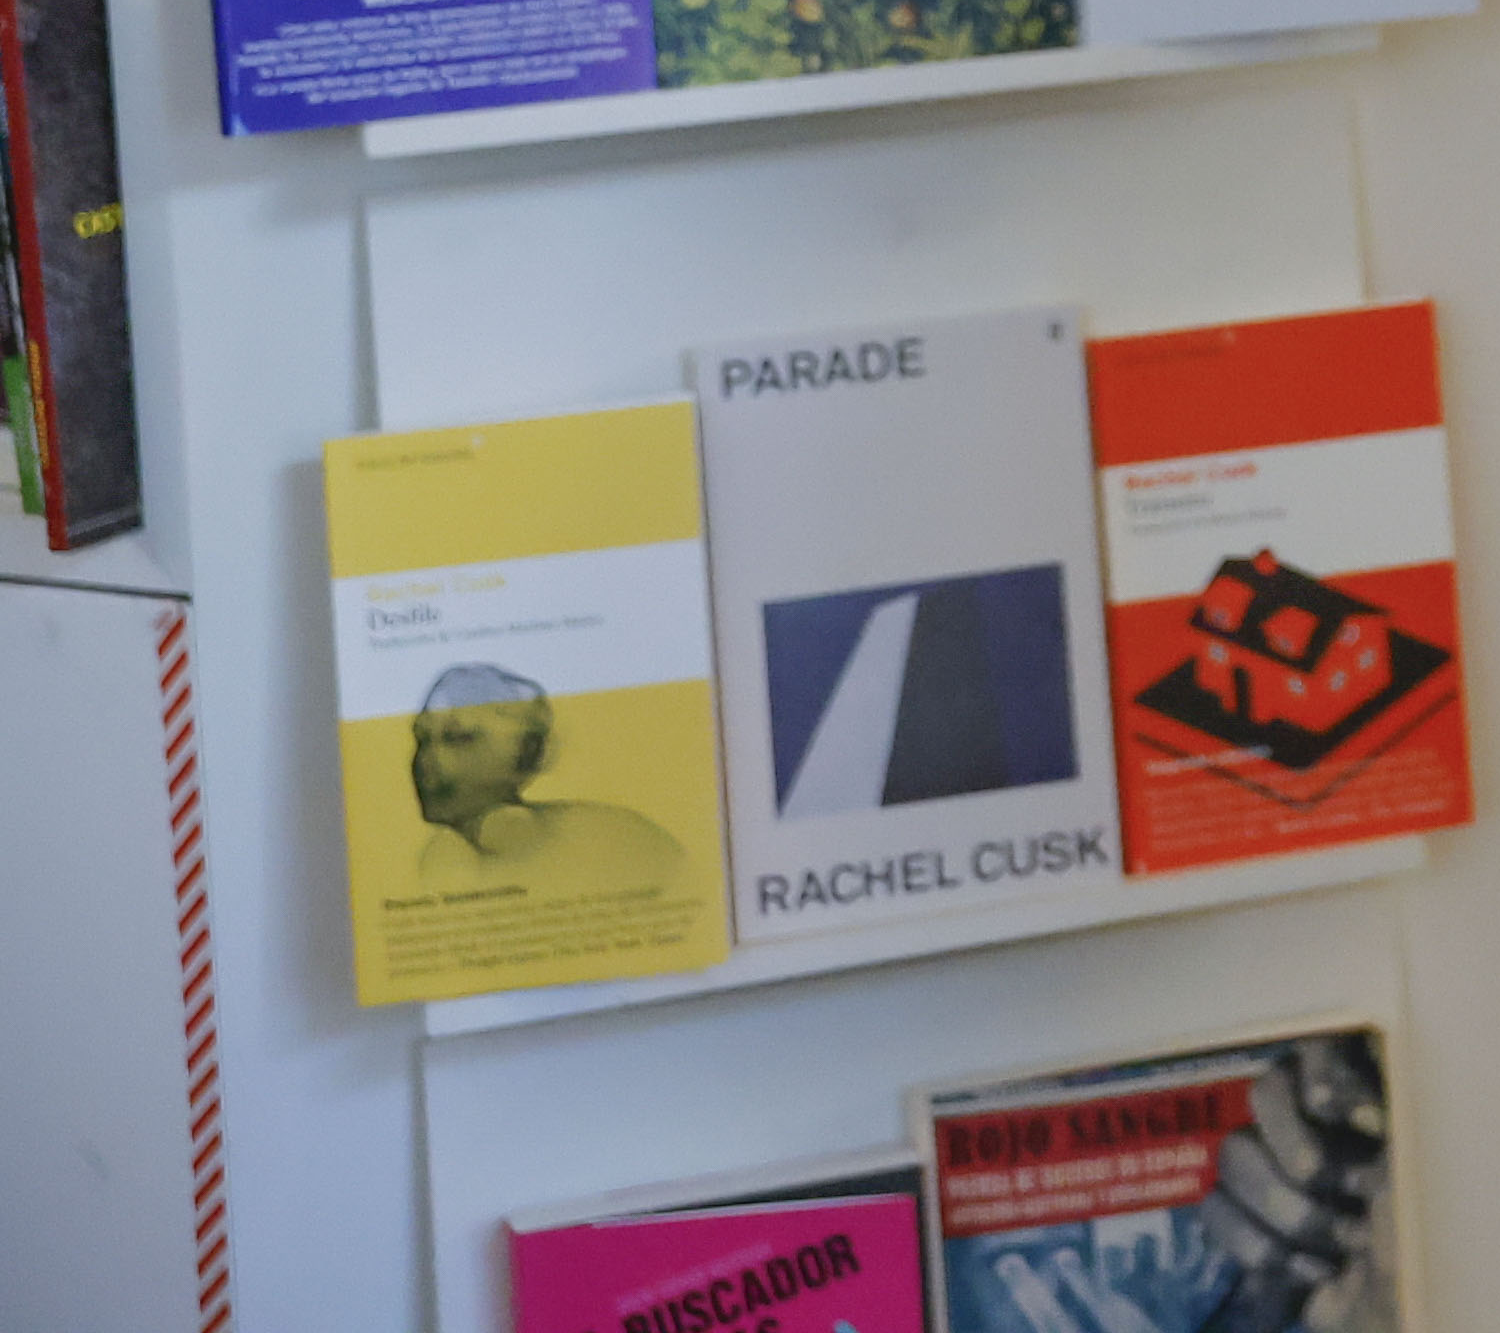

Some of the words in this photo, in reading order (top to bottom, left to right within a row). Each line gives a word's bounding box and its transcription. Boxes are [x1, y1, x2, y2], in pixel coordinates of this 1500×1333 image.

[721, 337, 926, 400] PARADE
[757, 844, 964, 917] RACHEL
[970, 830, 1109, 885] CUSK
[620, 1232, 862, 1333] BUSCADOR
